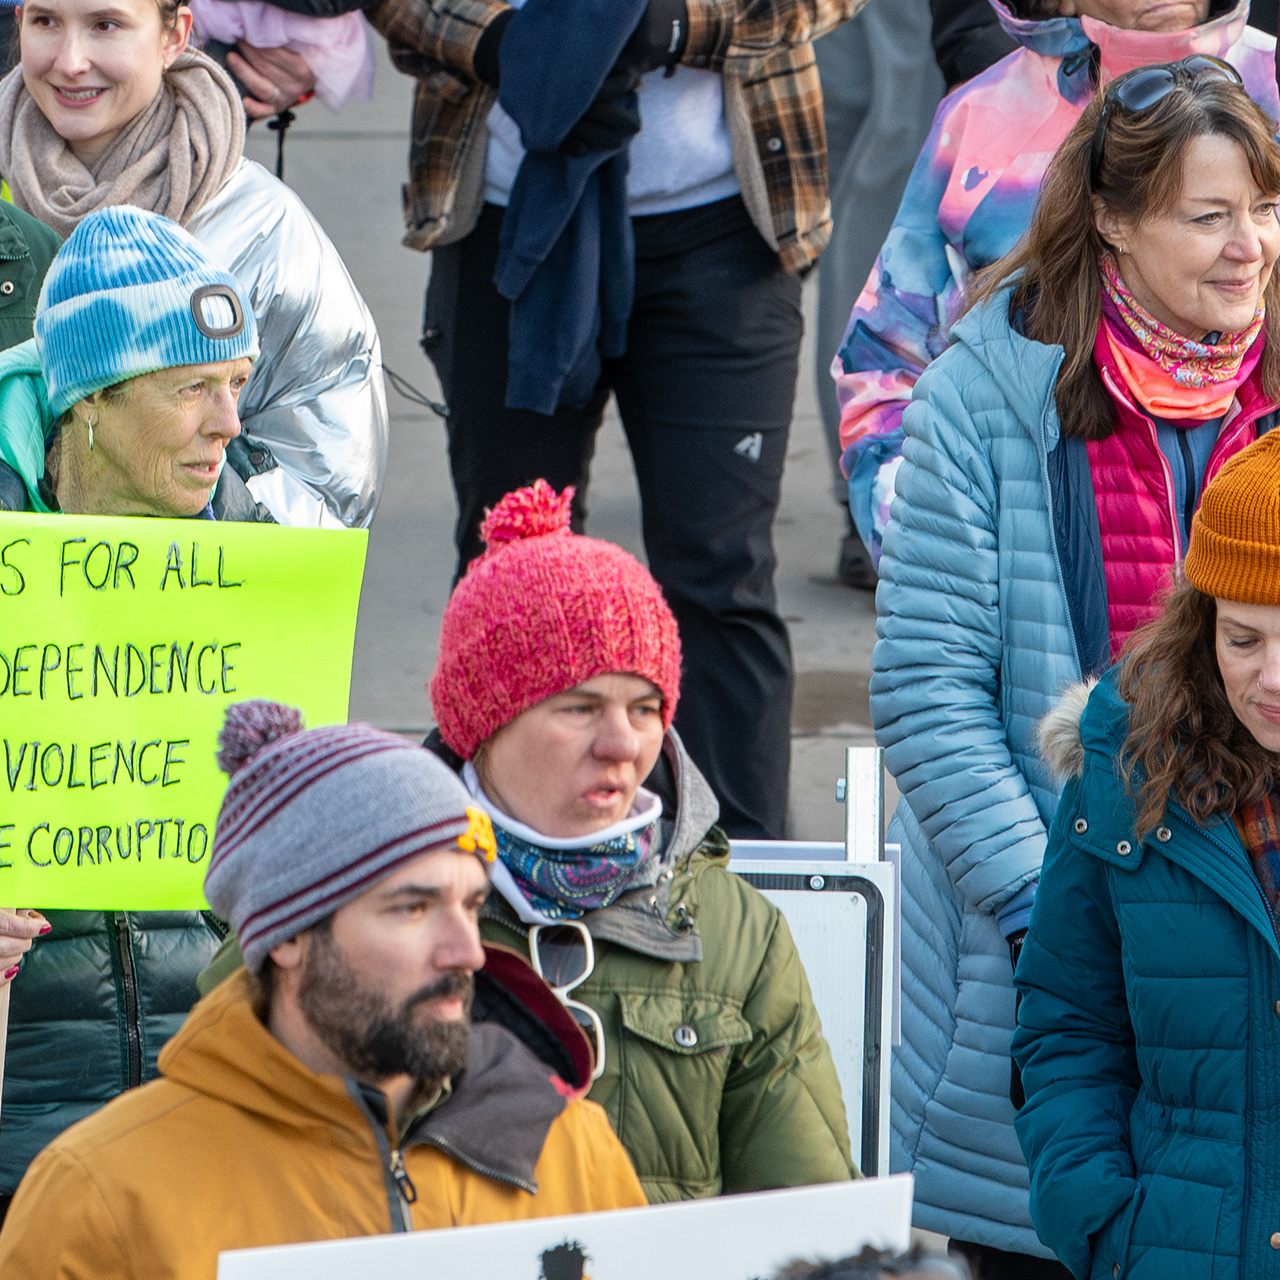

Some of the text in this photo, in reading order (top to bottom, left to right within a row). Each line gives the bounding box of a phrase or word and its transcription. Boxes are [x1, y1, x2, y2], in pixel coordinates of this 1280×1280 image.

[60, 537, 139, 597] FOR
[160, 541, 247, 591] ALL
[3, 738, 190, 792] VIOLENCE
[25, 816, 209, 868] CORRUPTIO
